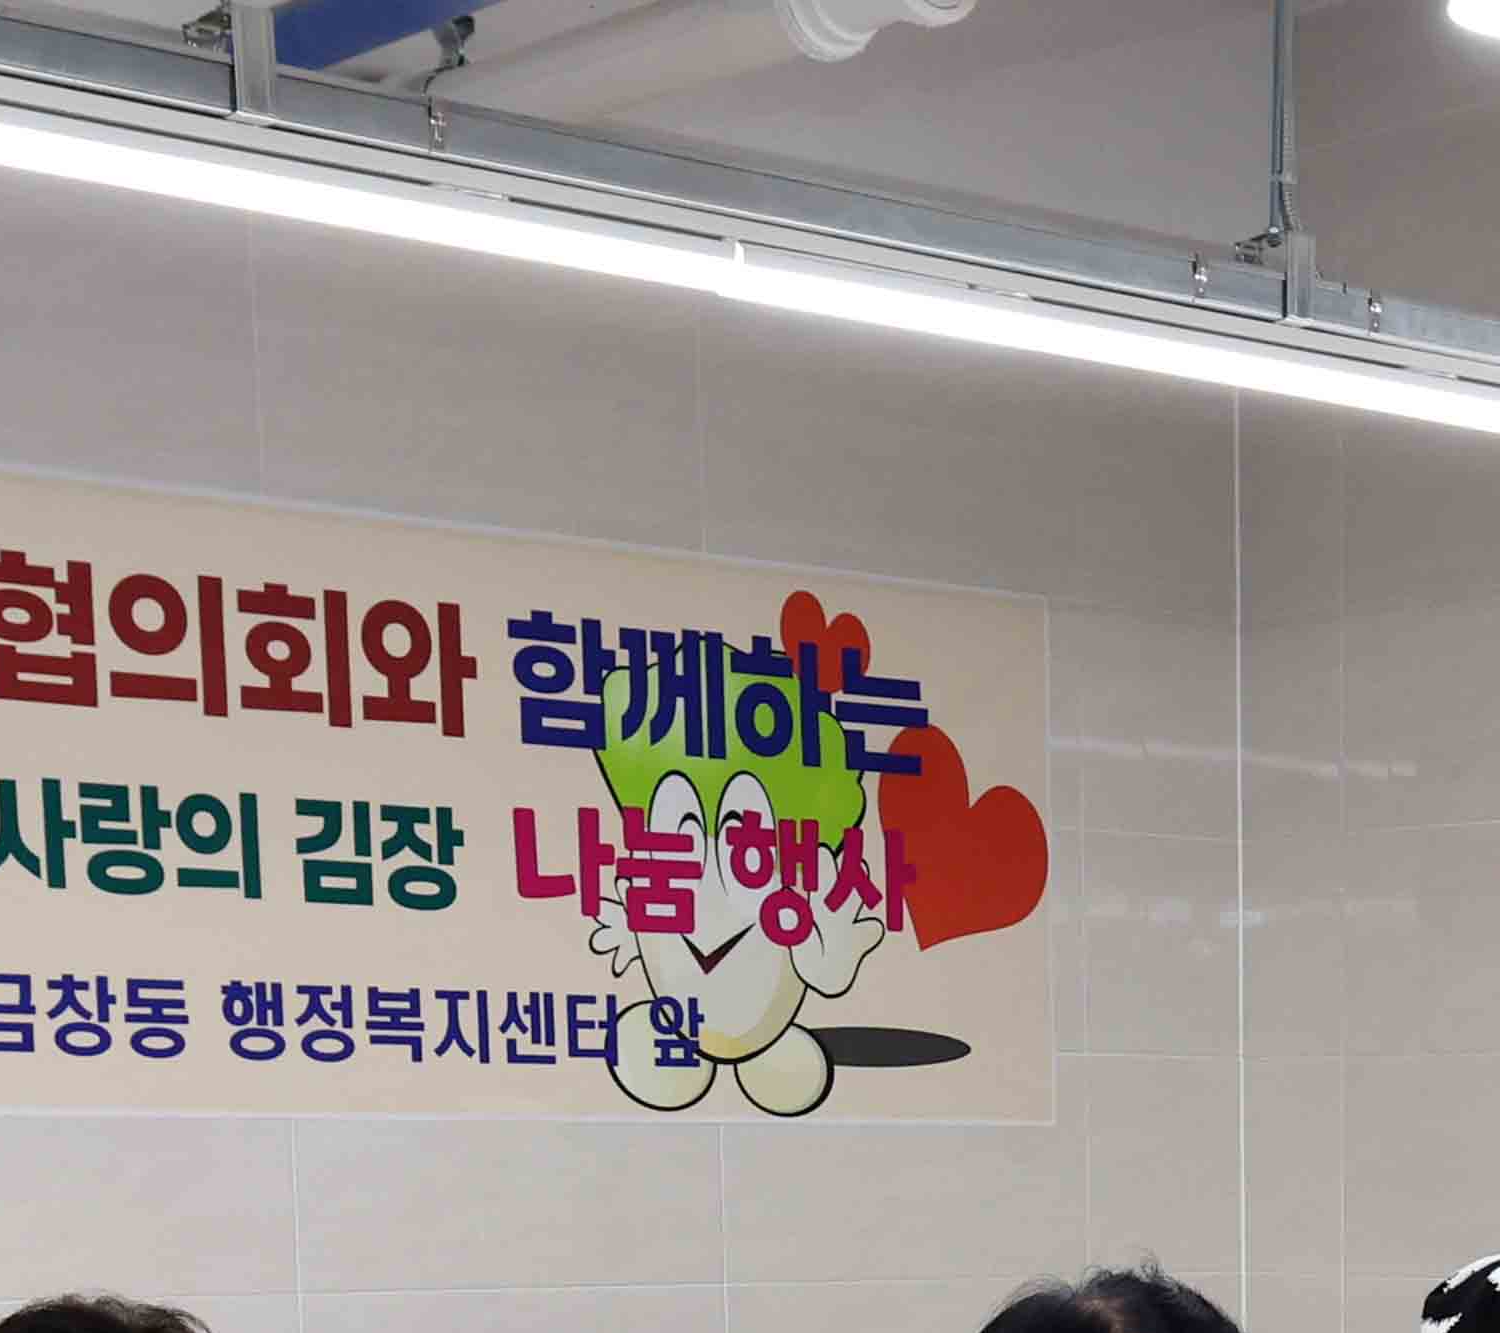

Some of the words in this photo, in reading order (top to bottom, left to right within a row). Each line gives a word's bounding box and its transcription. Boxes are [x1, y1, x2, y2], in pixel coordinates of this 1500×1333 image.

[506, 609, 929, 776] 함께하는
[294, 797, 464, 911] 김장
[513, 807, 702, 934] 나눔
[726, 810, 918, 947] 행사
[220, 979, 621, 1074] 행정복지센터
[648, 993, 706, 1070] 앞
